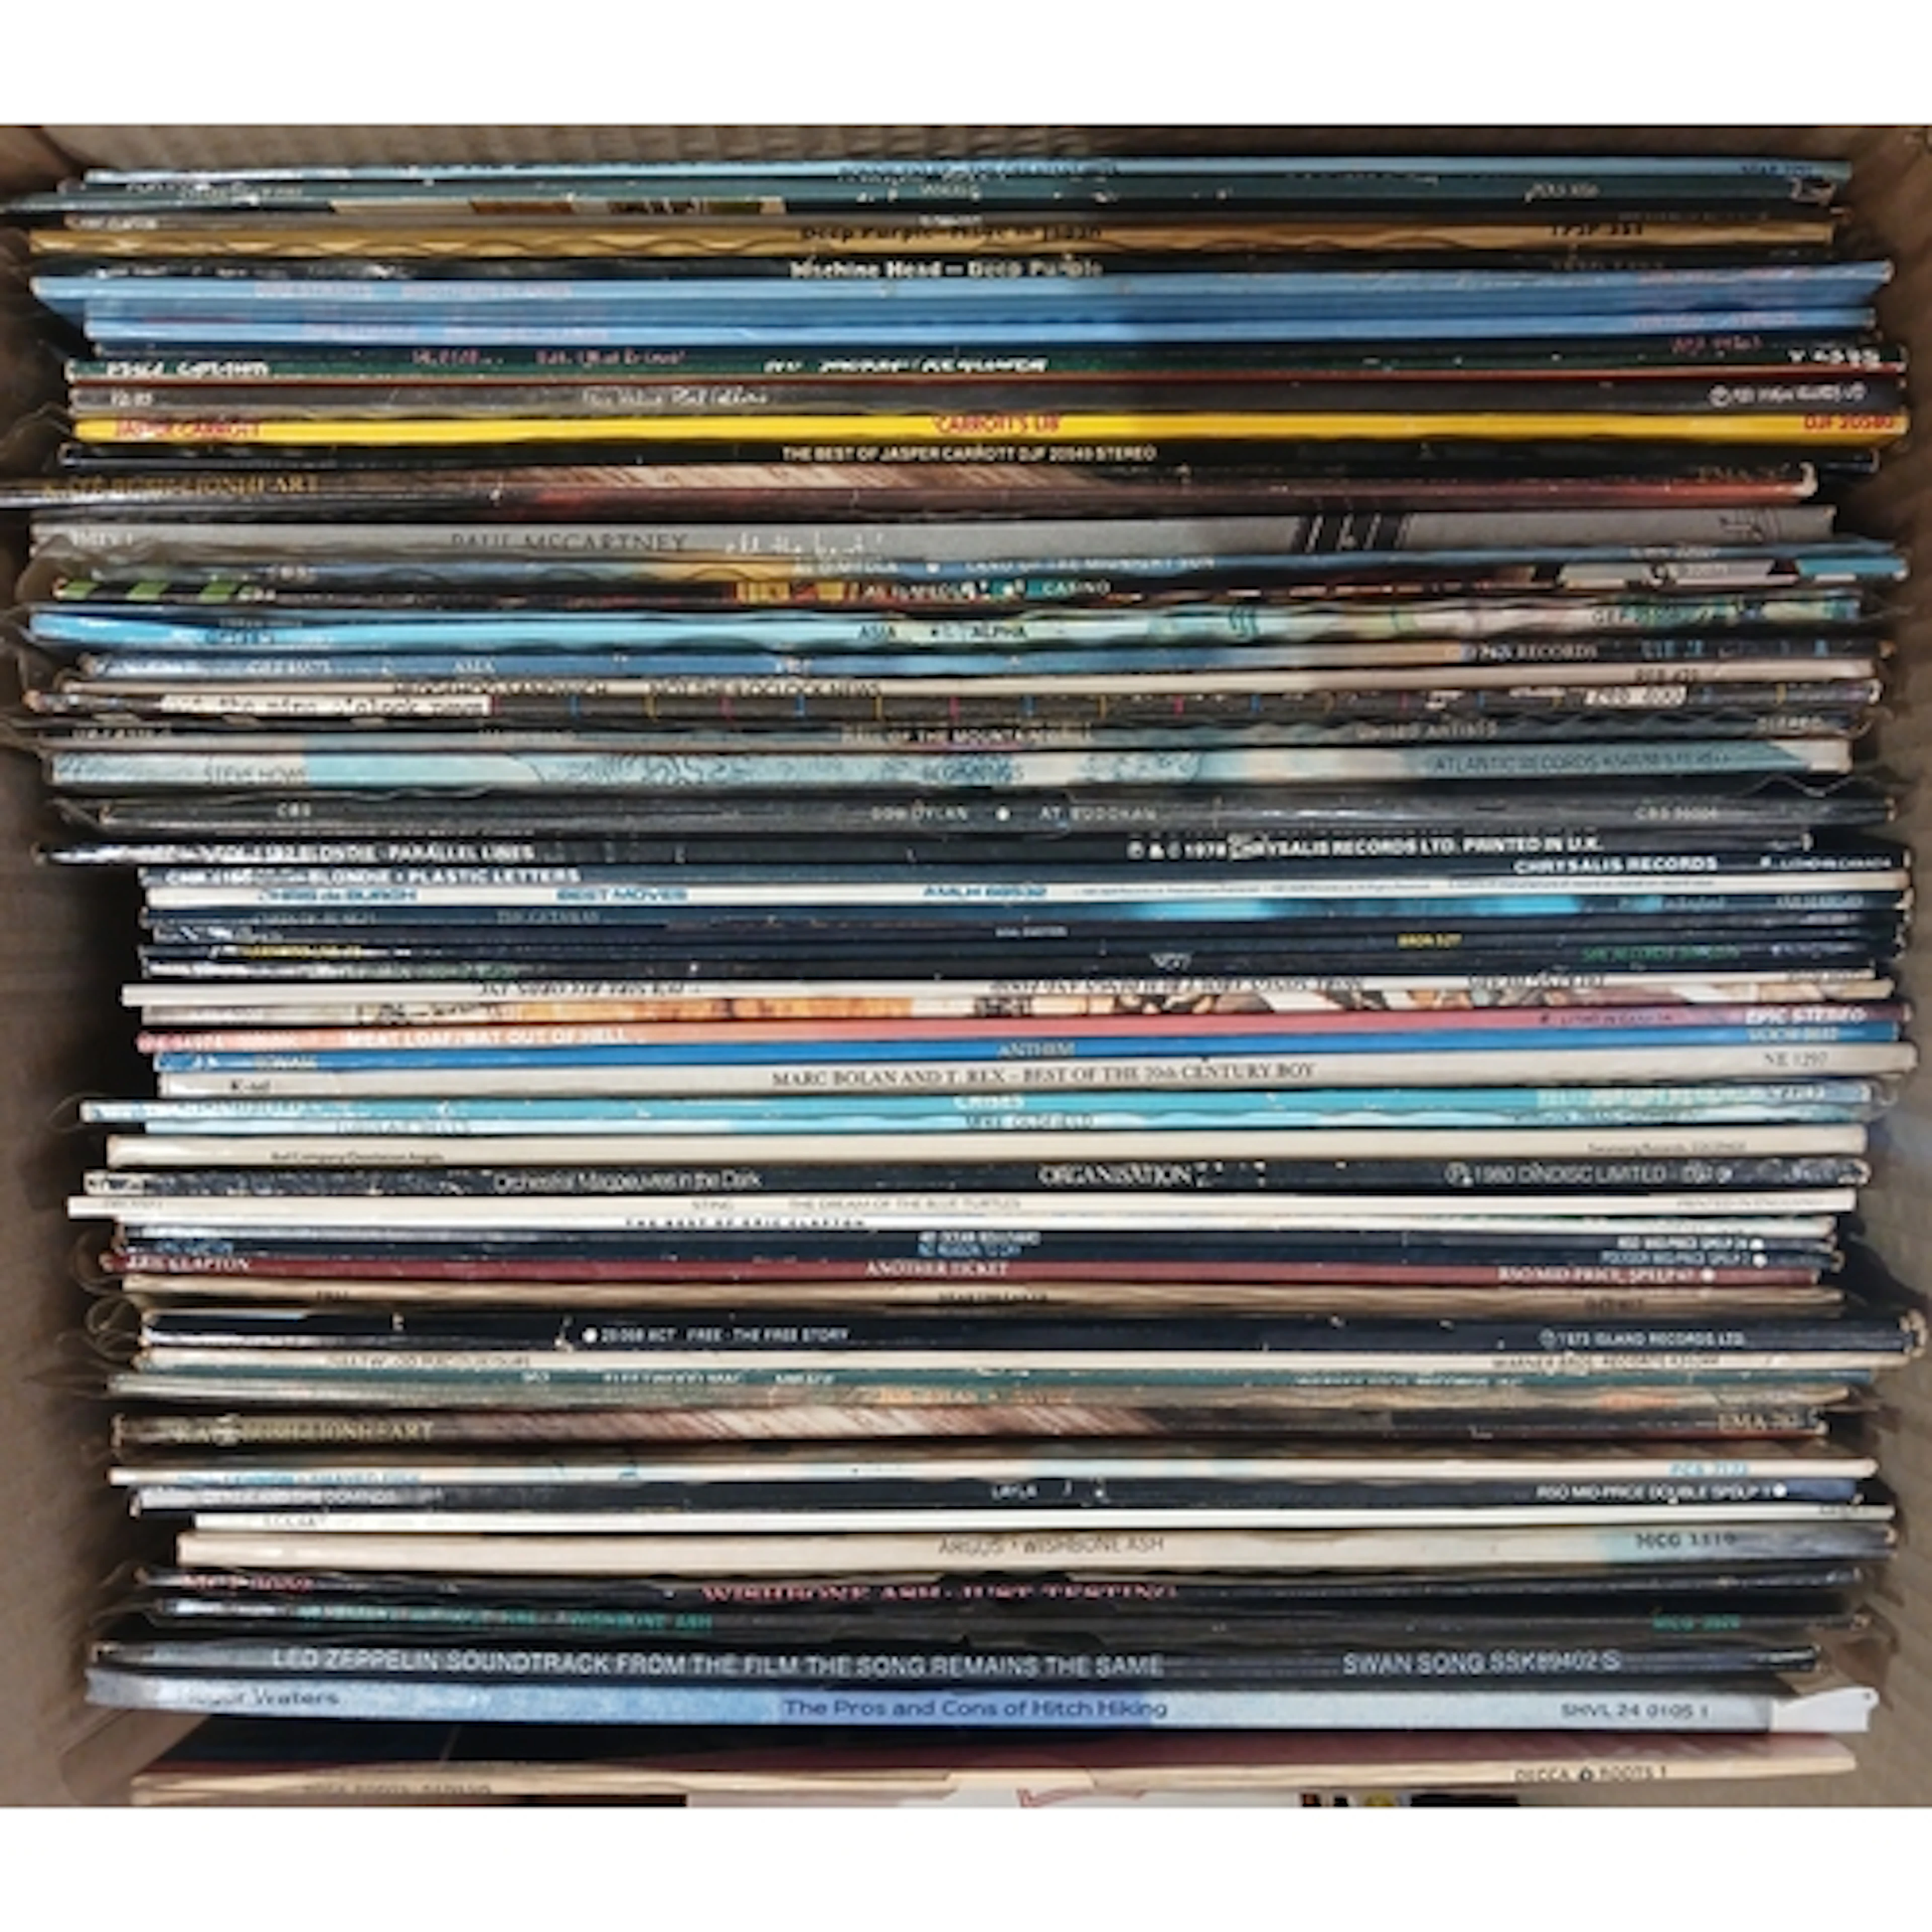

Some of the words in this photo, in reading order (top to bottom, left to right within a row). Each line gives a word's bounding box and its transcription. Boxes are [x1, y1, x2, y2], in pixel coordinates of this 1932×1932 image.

[782, 447, 810, 461] THE
[815, 447, 854, 461] BEST
[857, 447, 878, 461] OF
[880, 447, 939, 461] JASPER
[1331, 837, 1415, 857] RECORDS
[408, 868, 489, 883] PLASTIC
[492, 867, 581, 883] LETTERS
[1514, 856, 1624, 875] CHRYSALIS
[1626, 855, 1717, 872] RECORDS
[1745, 1009, 1787, 1024] EPIC
[772, 1071, 827, 1086] MARC
[832, 1070, 898, 1086] BOLAN
[901, 1069, 943, 1085] AND
[968, 1069, 1006, 1084] REX
[1023, 1068, 1069, 1083] BEST
[1075, 1067, 1095, 1083] OF
[1106, 1067, 1140, 1081] THE
[1182, 1063, 1270, 1079] CENTURY
[1278, 1063, 1315, 1078] BOY
[273, 1649, 317, 1668] LED
[325, 1649, 439, 1670] ZEPPELIN
[447, 1650, 608, 1674] SOUNDTRACK
[617, 1653, 685, 1674] FROM
[691, 1655, 739, 1675] THE
[744, 1655, 798, 1676] FILM
[807, 1656, 848, 1676] THE
[856, 1656, 925, 1677] SONG
[931, 1655, 1040, 1676] REMAINS
[1046, 1656, 1090, 1676] THE
[1095, 1656, 1165, 1676] SAME
[1343, 1653, 1411, 1674] SWAN
[1417, 1653, 1484, 1674] SONG
[783, 1699, 827, 1716] The
[834, 1699, 887, 1716] Pros
[893, 1699, 935, 1716] and
[941, 1700, 999, 1716] Cons
[1005, 1699, 1028, 1716] of
[1032, 1700, 1092, 1716] Hitch
[1097, 1700, 1168, 1719] Hiking
[1618, 1703, 1639, 1717] 24
